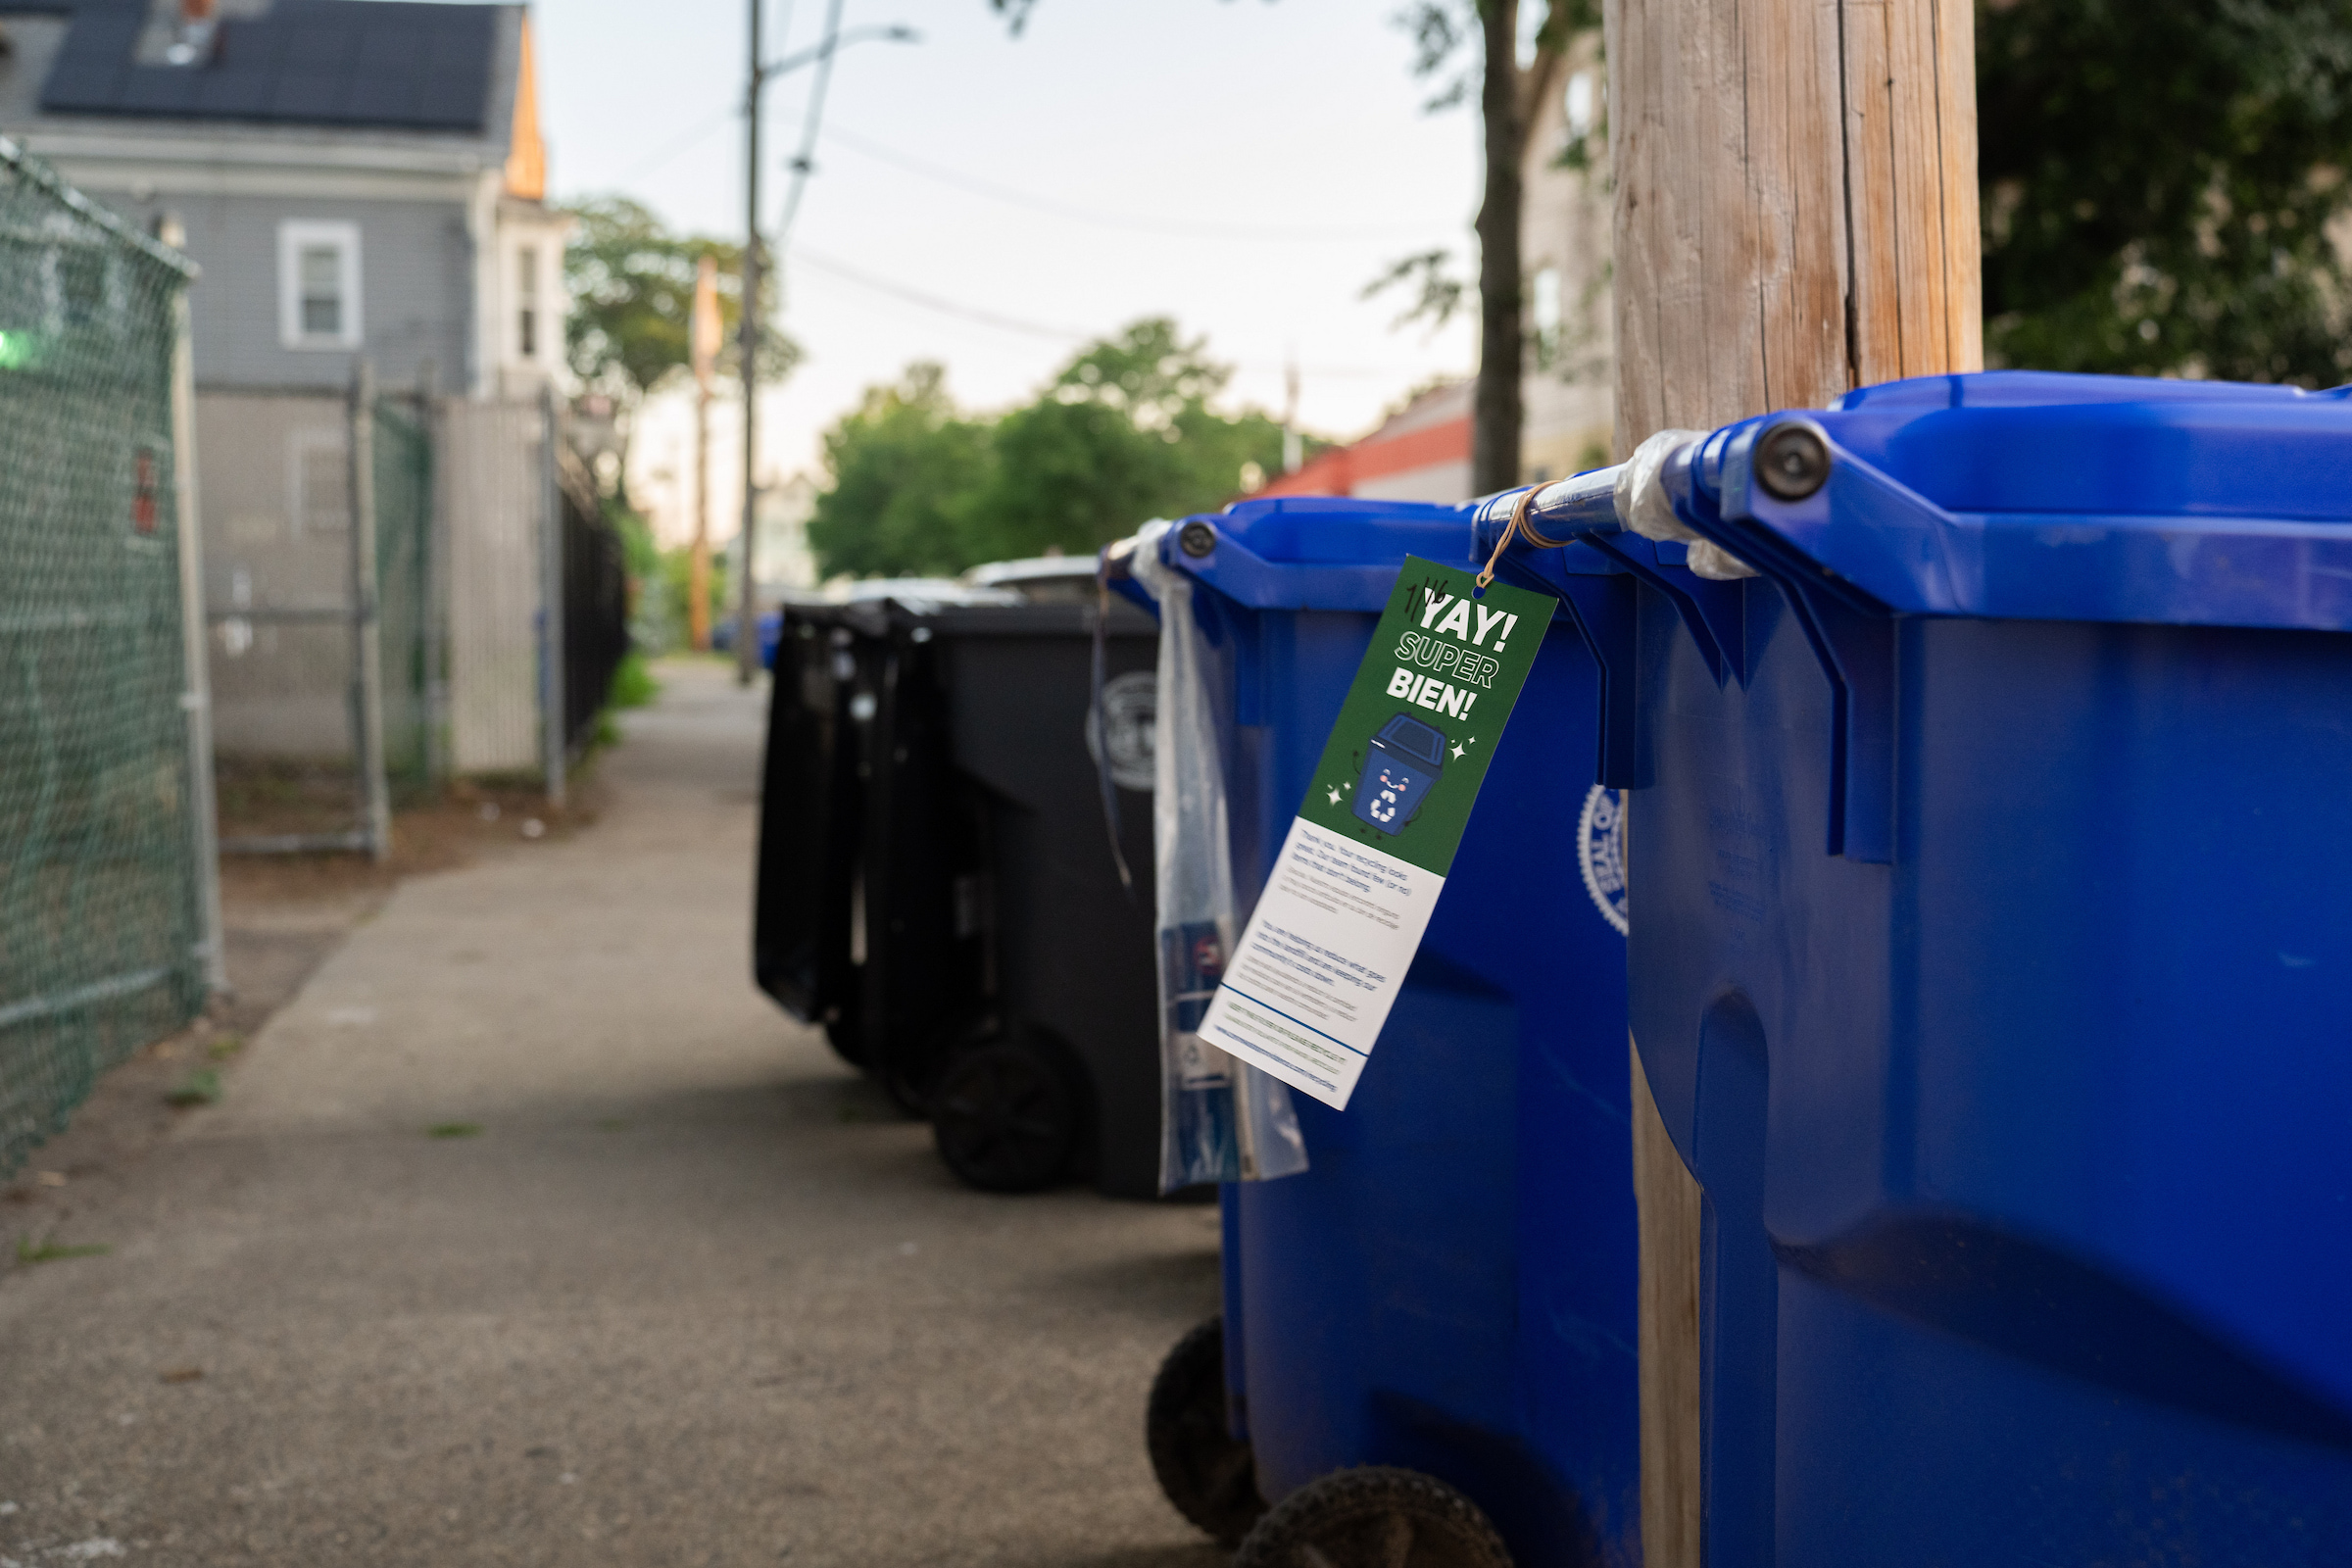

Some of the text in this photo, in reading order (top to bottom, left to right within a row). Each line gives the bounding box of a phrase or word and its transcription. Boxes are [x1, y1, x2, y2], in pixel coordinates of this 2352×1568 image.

[1419, 586, 1518, 653] YAY!
[1394, 631, 1499, 689] SUPER
[1386, 666, 1478, 721] BIEN!
